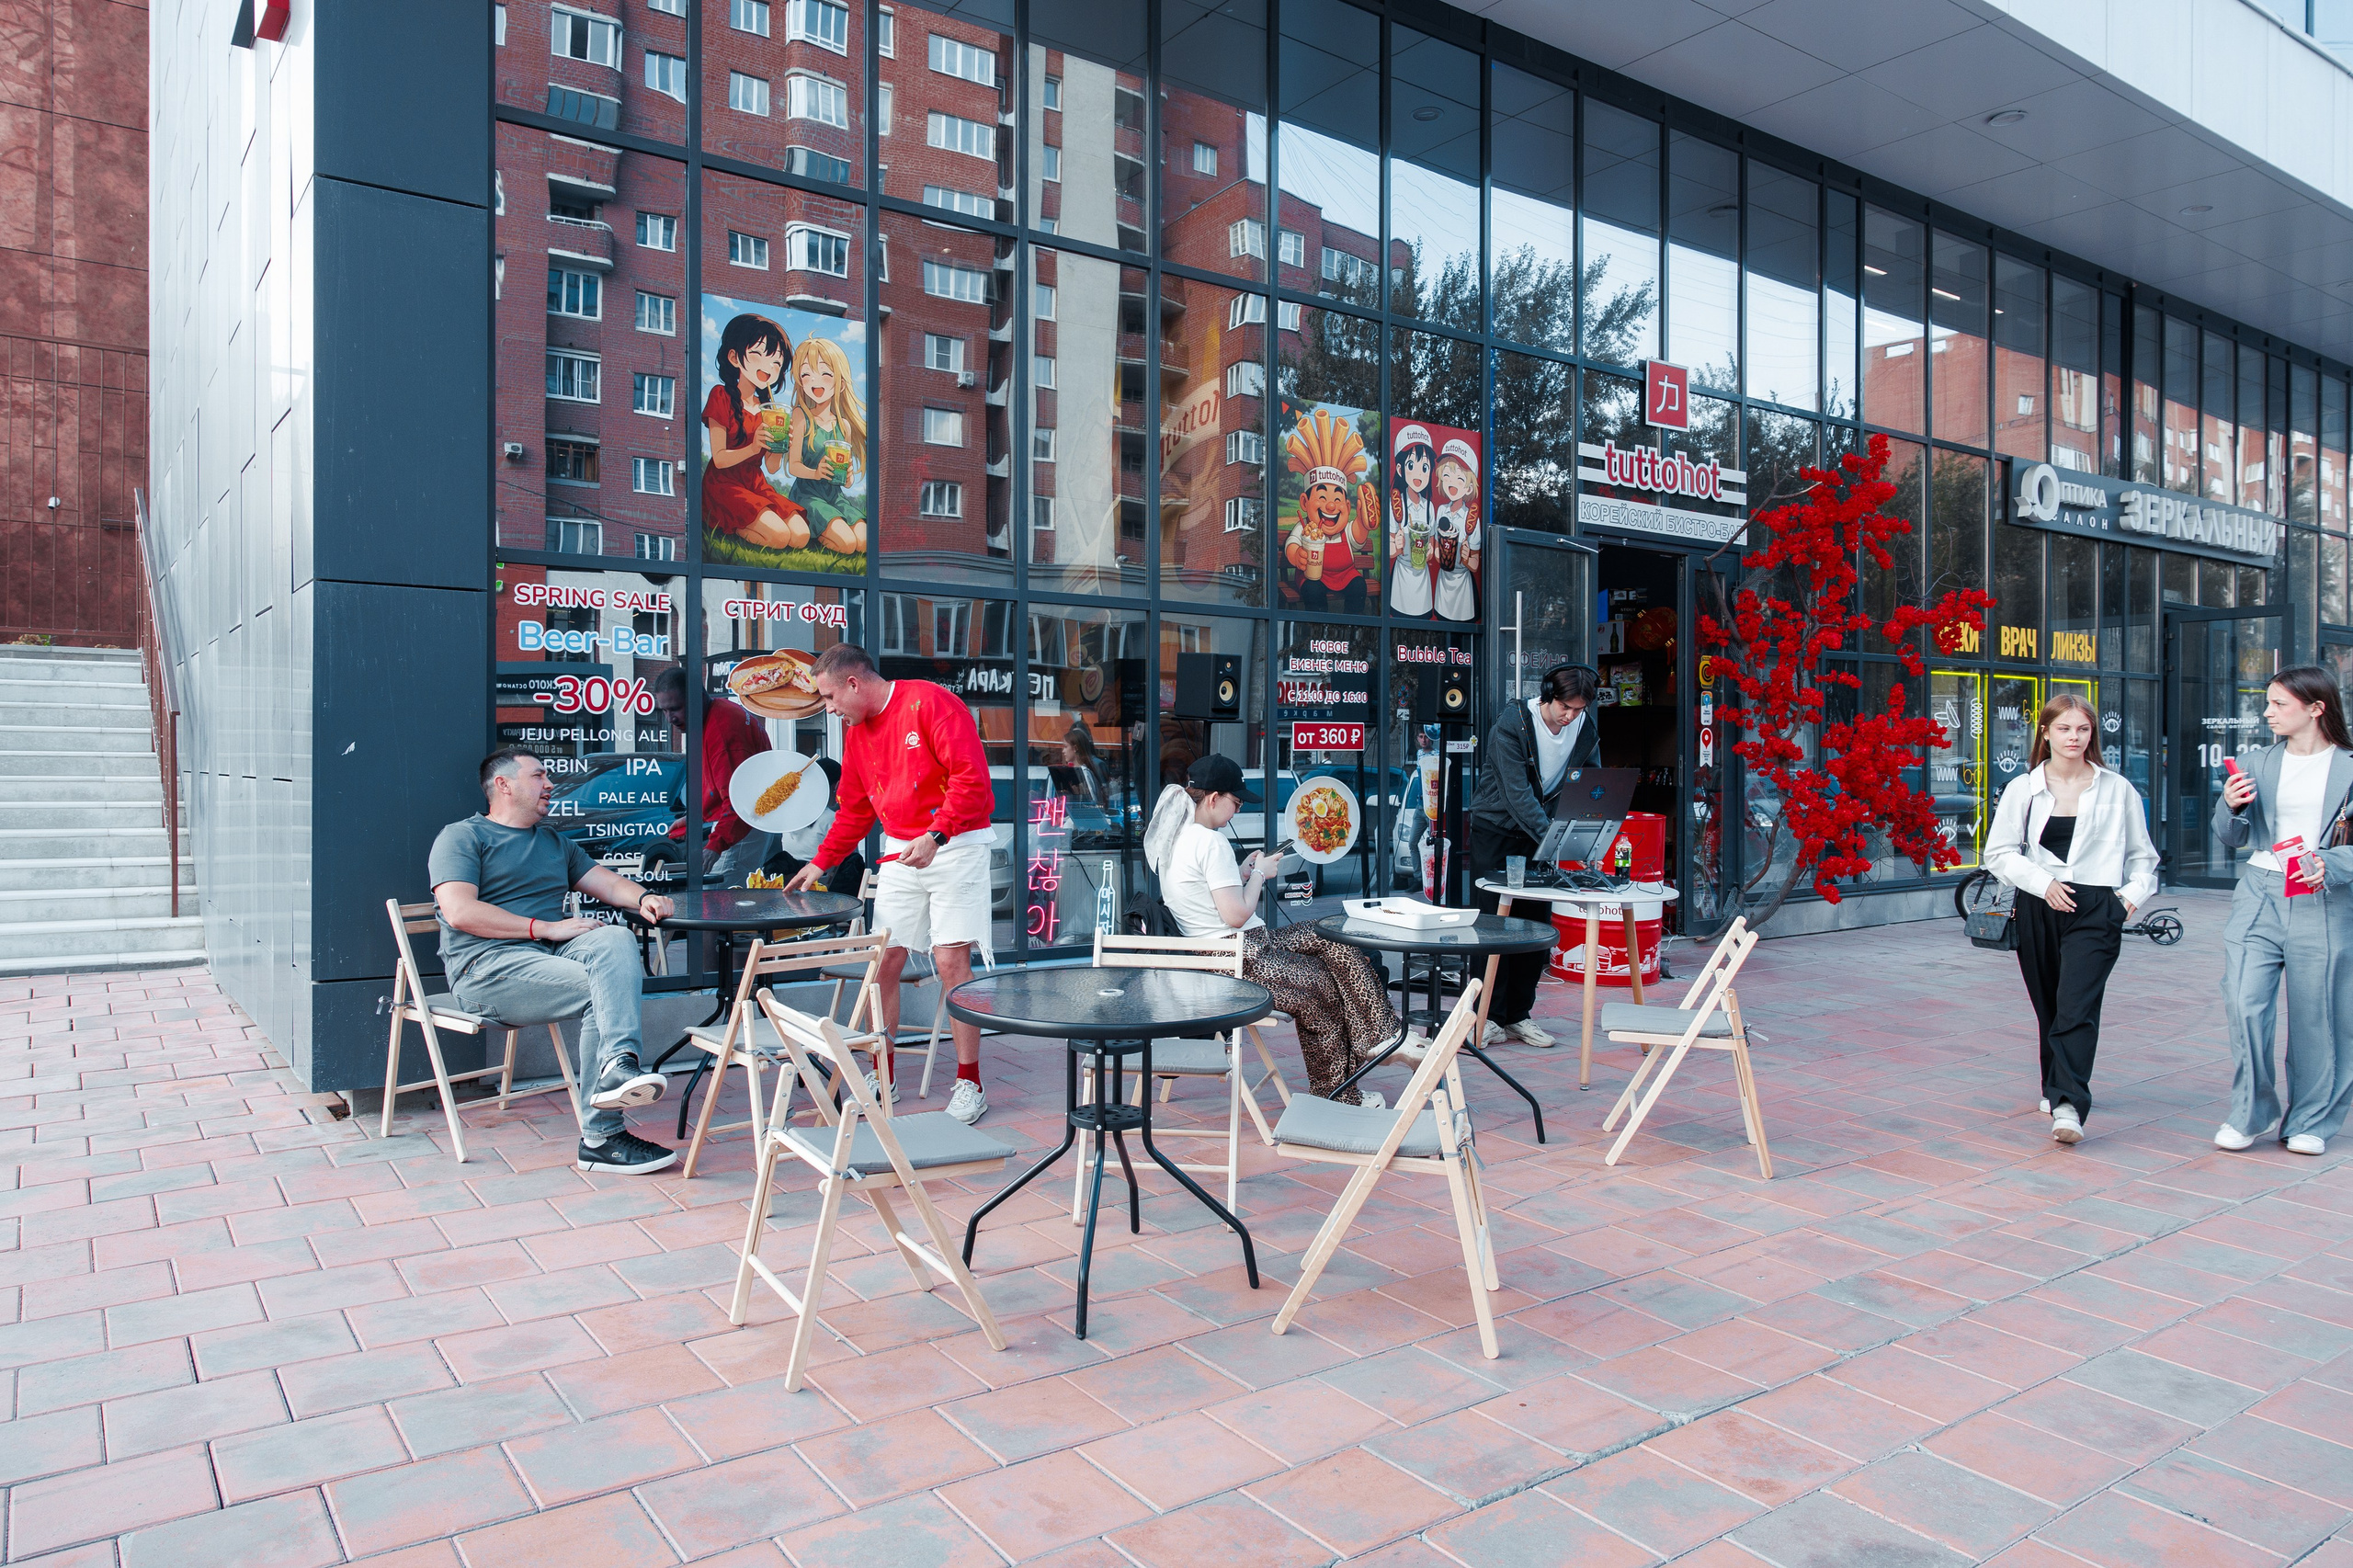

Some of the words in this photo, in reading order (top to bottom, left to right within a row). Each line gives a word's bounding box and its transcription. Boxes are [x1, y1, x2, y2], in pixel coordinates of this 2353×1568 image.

[1406, 431, 1430, 443] tuttohot
[1445, 445, 1468, 458] tuttohot
[1318, 470, 1347, 487] tuttohot
[1605, 441, 1722, 500] tuttohot
[1580, 501, 1664, 530] КОРЕЙСКИЙ
[1665, 515, 1745, 542] БИСТРО-БАР
[2120, 490, 2277, 556] ЗЕРКАЛЬНЫЙ
[514, 583, 606, 607] SPRING
[612, 591, 672, 613] SALE
[722, 598, 795, 620] СТРИТ
[798, 603, 847, 628] ФУД
[518, 620, 668, 657] Beer-Bar
[2001, 626, 2037, 658] ВРАЧ
[1311, 641, 1348, 654] НОВОЕ
[2052, 631, 2096, 663] ЛИНЗЫ
[1398, 646, 1446, 664] Bubble
[1449, 648, 1471, 665] Tea
[1506, 649, 1568, 669] ОФЕЙНЯ
[1290, 659, 1333, 672] БИЗНЕС
[1336, 660, 1369, 674] МЕНЮ
[533, 675, 655, 715] -30%
[1289, 690, 1296, 701] С
[1298, 690, 1324, 702] 11:00
[1324, 691, 1341, 703] ДО
[1343, 691, 1368, 703] 16:00
[2201, 716, 2260, 725] ЗЕРКАЛЬНЫЙ
[519, 728, 553, 741] JEJU
[560, 729, 632, 742] PELLONG
[639, 730, 668, 742] ALE
[1297, 732, 1314, 744] от
[1319, 729, 1347, 744] 360
[2198, 744, 2222, 767] 10
[544, 758, 588, 773] RBIN
[626, 758, 663, 776] IPA
[598, 792, 635, 804] PALE
[640, 791, 668, 803] ALE
[548, 801, 585, 817] ZEL
[585, 824, 668, 837] TSINGTAO
[603, 852, 642, 863] GOSE
[635, 870, 673, 882] SOUL
